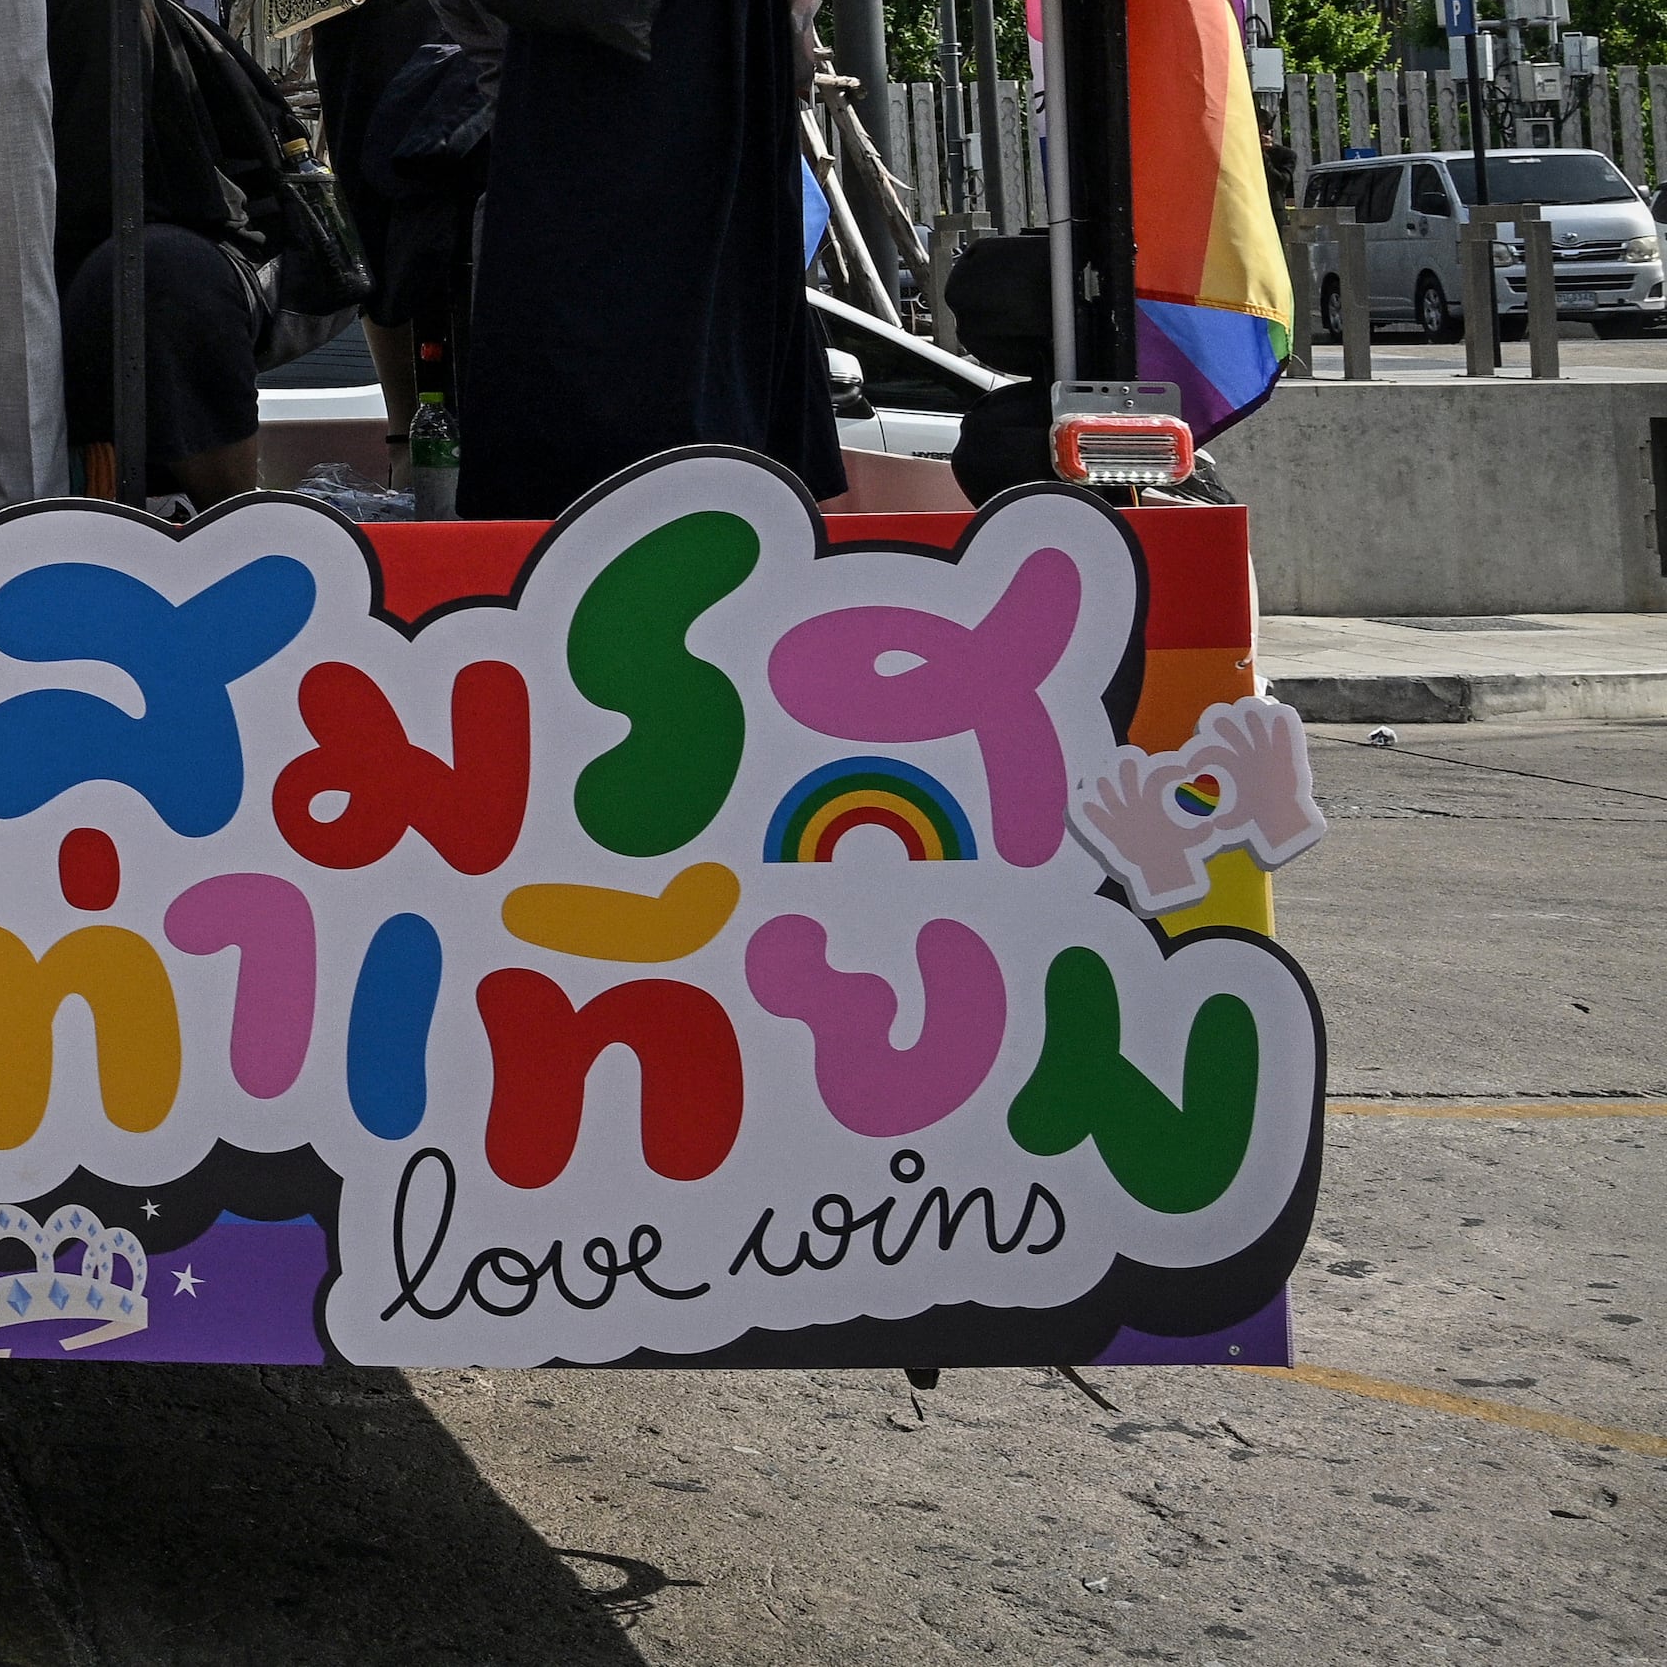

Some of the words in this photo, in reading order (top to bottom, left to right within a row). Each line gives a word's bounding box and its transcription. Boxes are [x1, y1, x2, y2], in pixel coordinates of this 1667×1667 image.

[1452, 0, 1462, 27] P
[378, 1146, 711, 1324] love
[730, 1146, 1066, 1282] wins
